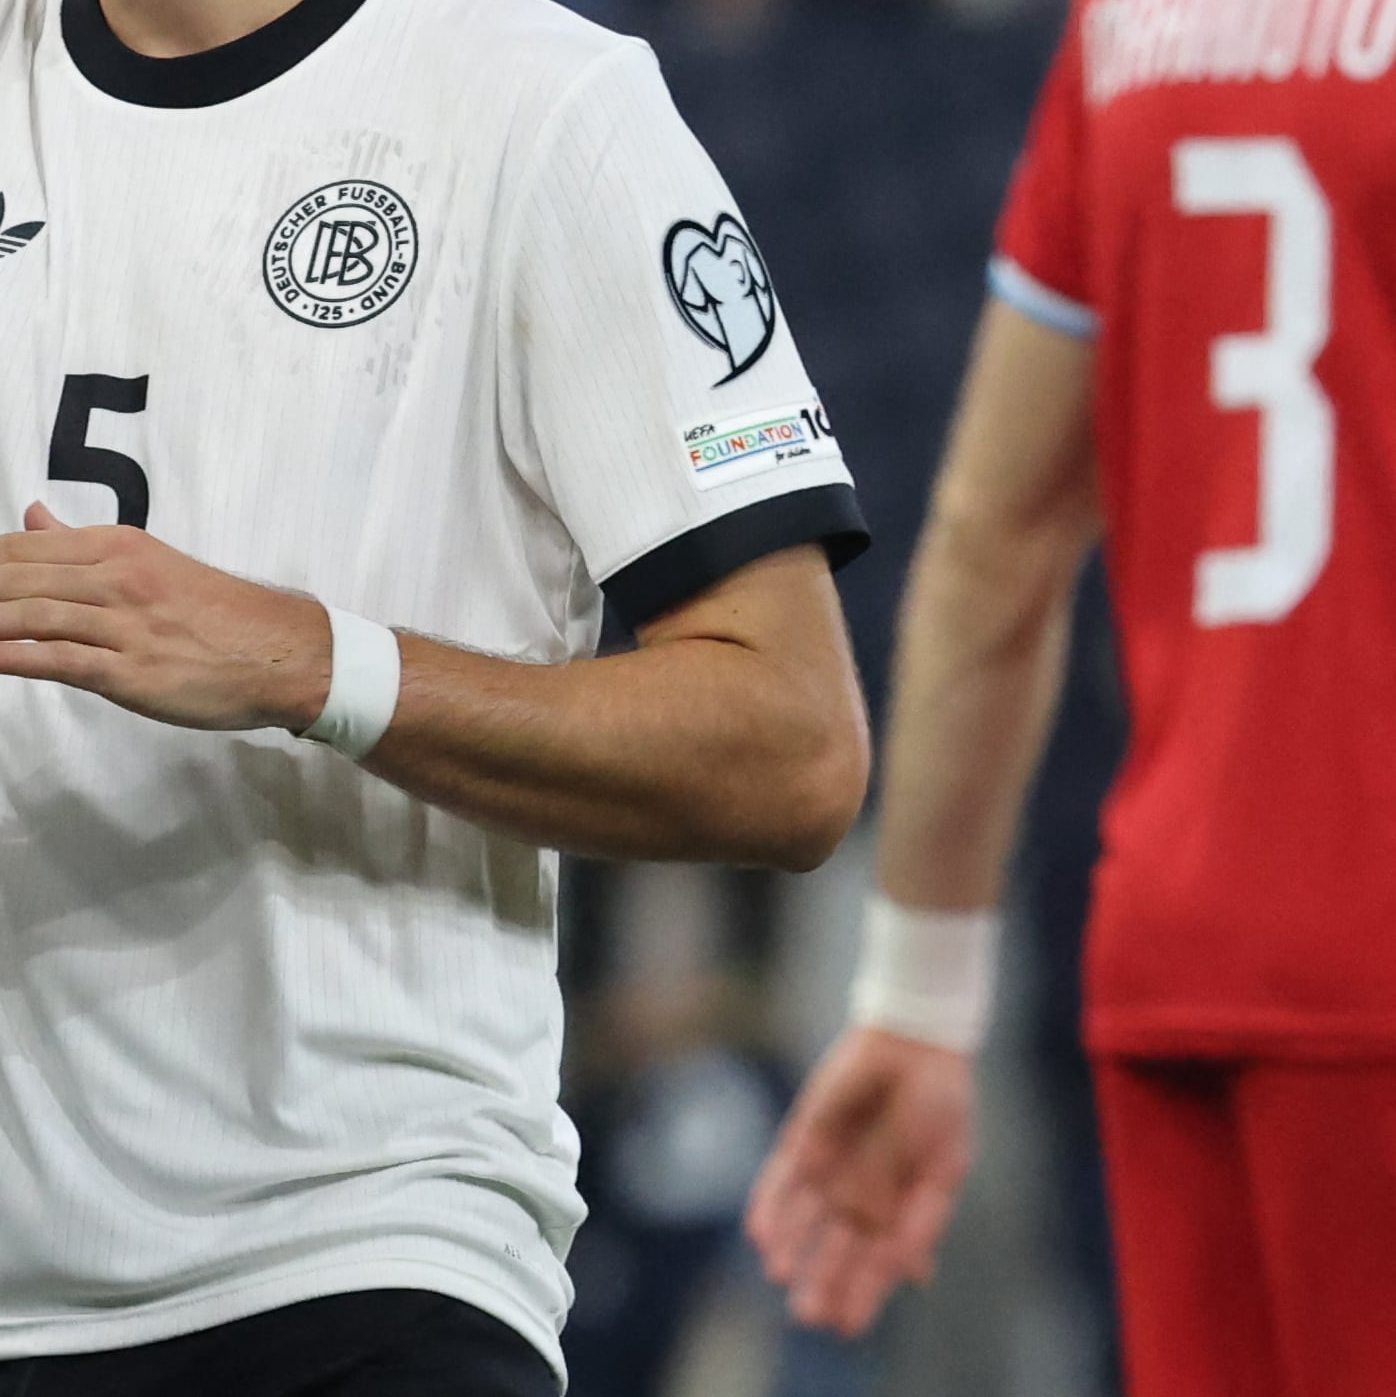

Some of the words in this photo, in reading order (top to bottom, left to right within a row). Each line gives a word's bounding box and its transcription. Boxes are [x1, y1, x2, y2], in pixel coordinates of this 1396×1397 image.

[271, 193, 328, 304] DEUTSCHER
[337, 186, 410, 311] FUSSBALL-BUND
[304, 220, 380, 287] DFB
[310, 303, 343, 321] 125
[1170, 135, 1335, 629] 3
[47, 373, 150, 531] 5
[683, 424, 716, 443] UEFA
[689, 422, 805, 467] FOUNDATION
